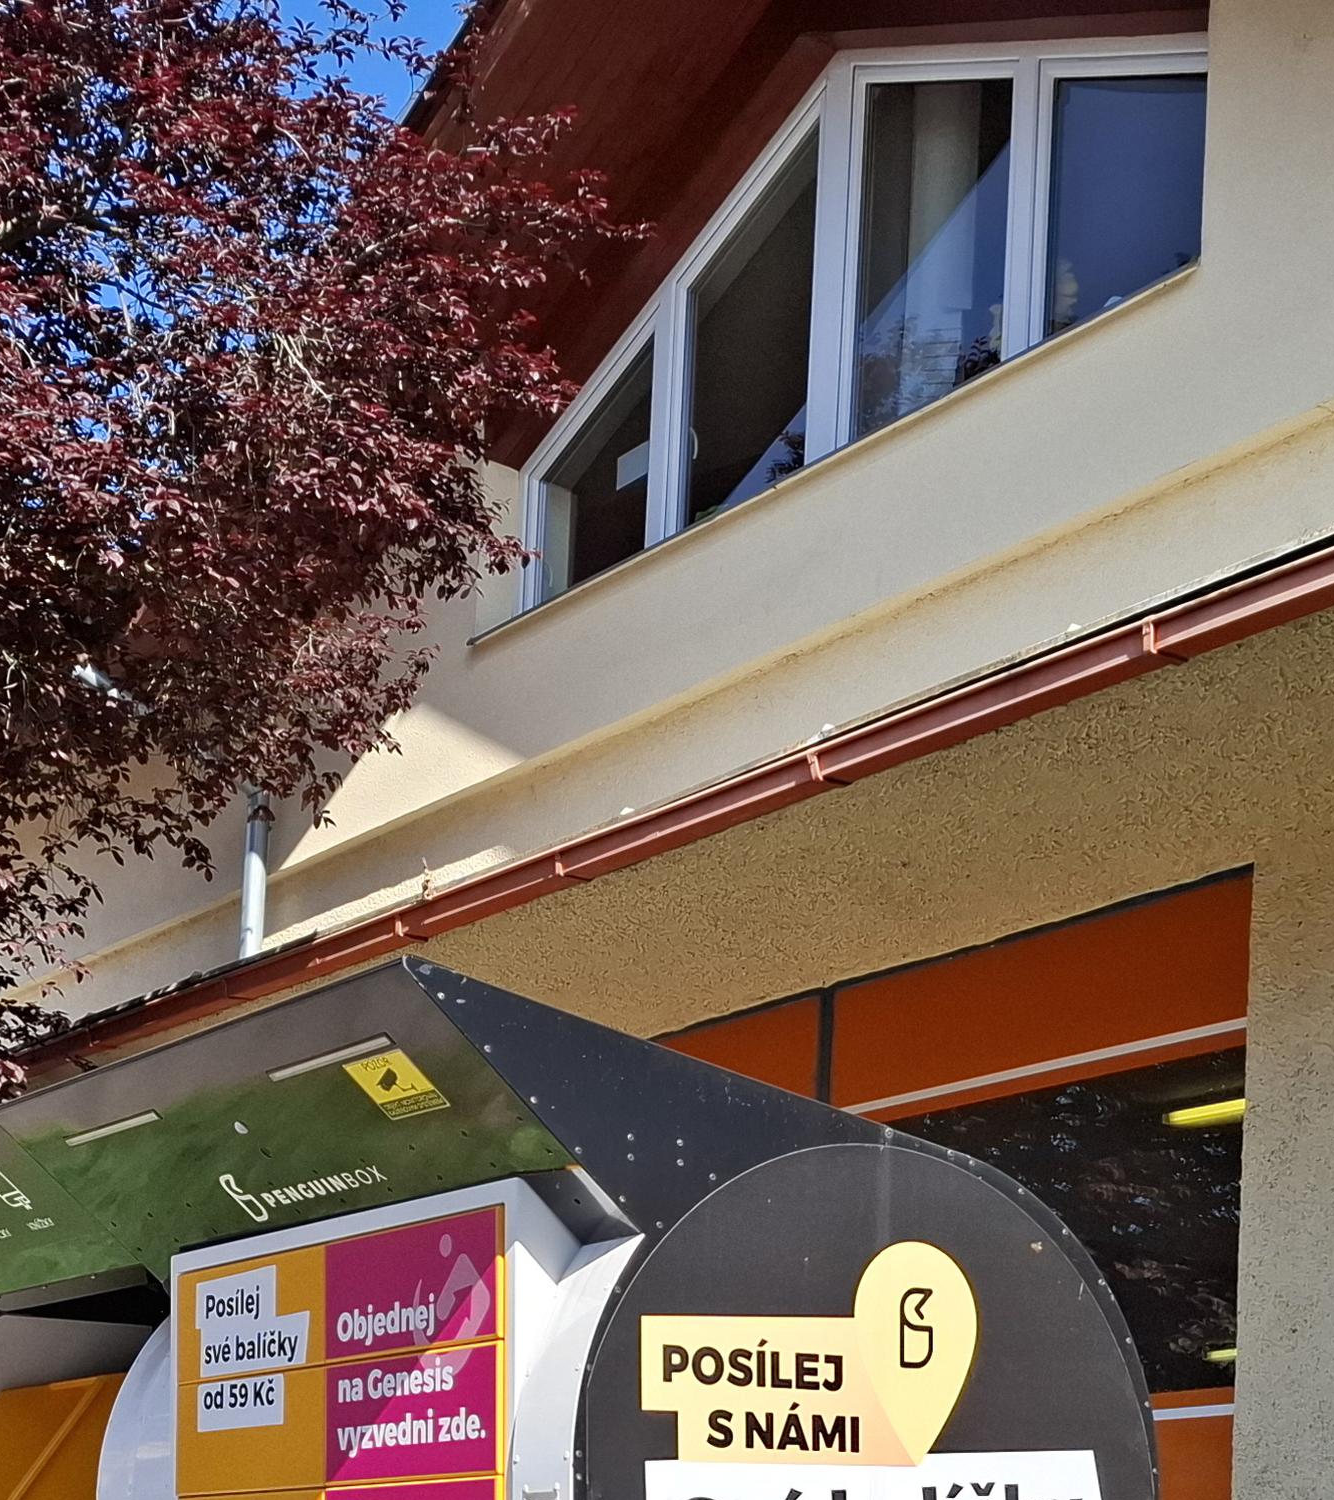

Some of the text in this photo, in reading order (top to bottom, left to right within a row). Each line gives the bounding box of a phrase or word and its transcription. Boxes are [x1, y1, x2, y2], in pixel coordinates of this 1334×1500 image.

[260, 1165, 388, 1208] PENGUINBOX
[205, 1284, 259, 1321] Posílej
[337, 1294, 436, 1342] Objednej
[205, 1328, 298, 1364] své balíčky
[662, 1339, 844, 1392] POSÍLEJ
[204, 1377, 275, 1410] od 59 Kč
[338, 1357, 454, 1403] na Genesis
[338, 1407, 486, 1457] vyzvedni zde.
[707, 1402, 860, 1454] S NÁMI
